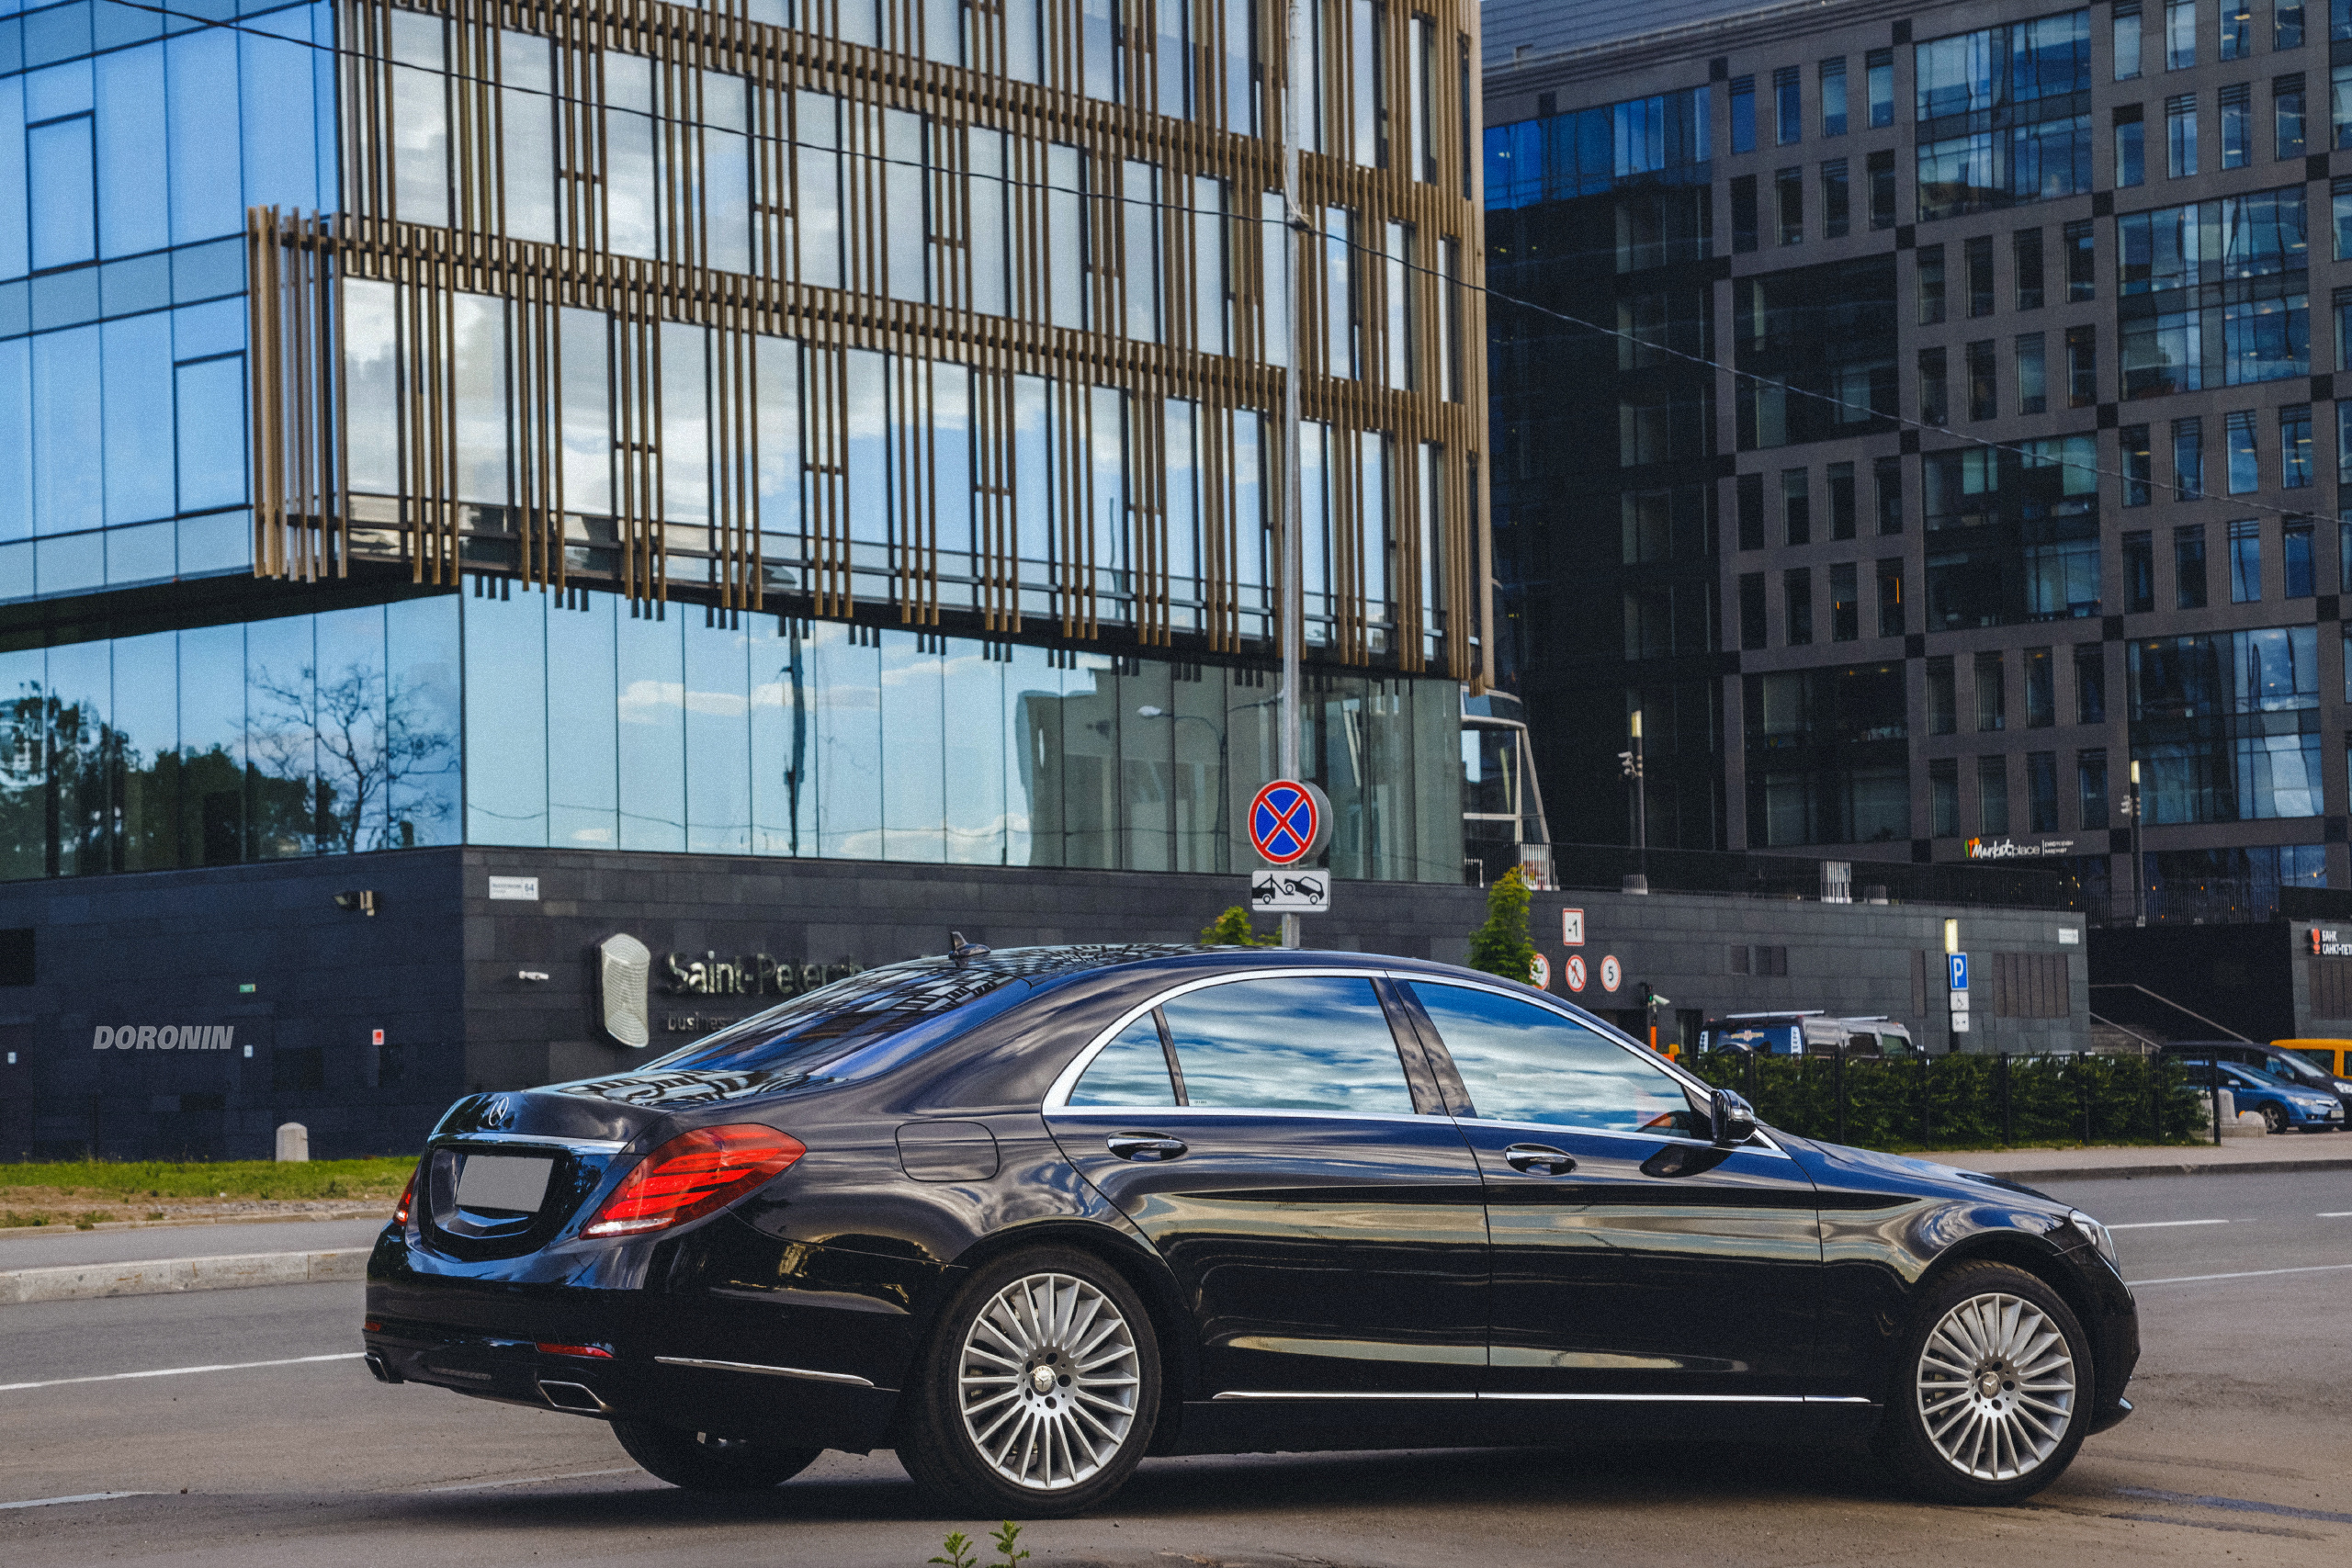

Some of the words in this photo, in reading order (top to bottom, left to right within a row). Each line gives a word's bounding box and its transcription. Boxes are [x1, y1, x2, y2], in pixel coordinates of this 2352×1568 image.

[2322, 930, 2337, 942] БАНК
[1608, 965, 1614, 982] 5
[1953, 958, 1963, 987] P
